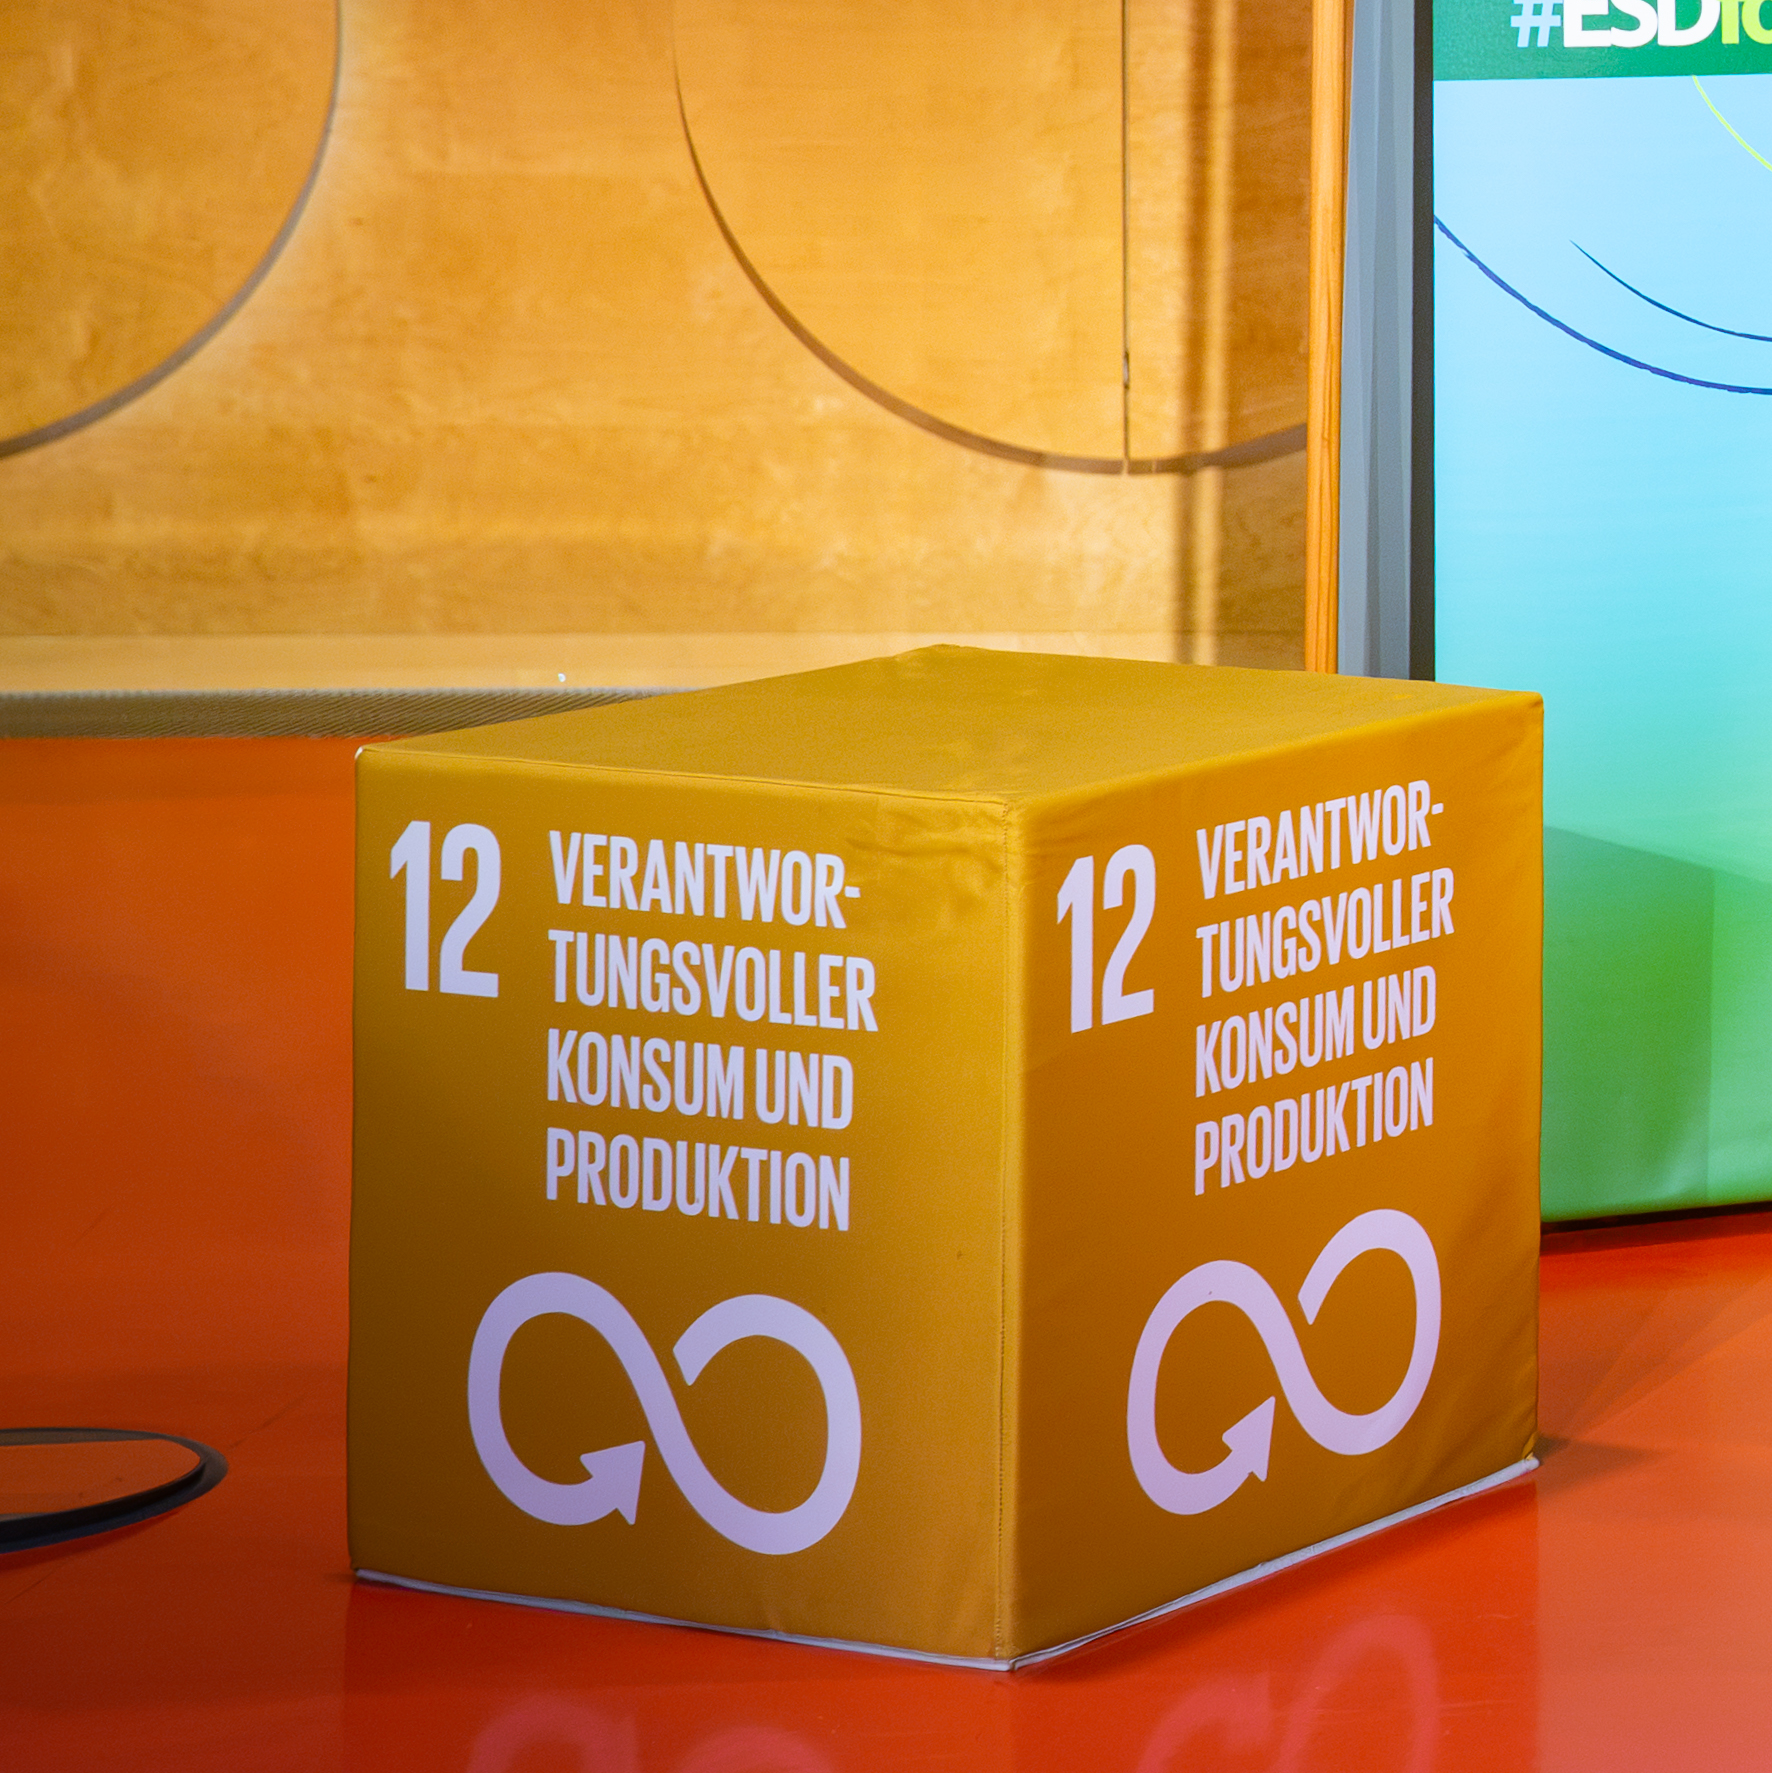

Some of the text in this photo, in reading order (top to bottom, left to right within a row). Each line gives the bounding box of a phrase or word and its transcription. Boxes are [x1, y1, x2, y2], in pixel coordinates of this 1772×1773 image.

[549, 829, 861, 929] VERANTWOR-
[1196, 780, 1444, 900] VERANTWOR-
[389, 820, 500, 998] 12
[1057, 844, 1156, 1034] 12
[1196, 867, 1455, 999] TUNGSVOLLER
[548, 929, 878, 1032] TUNGSVOLLER
[1195, 965, 1436, 1098] KONSUM UND
[547, 1027, 853, 1130] KONSUM UND
[1194, 1057, 1434, 1196] PRODUKTION
[546, 1127, 850, 1231] PRODUKTION
